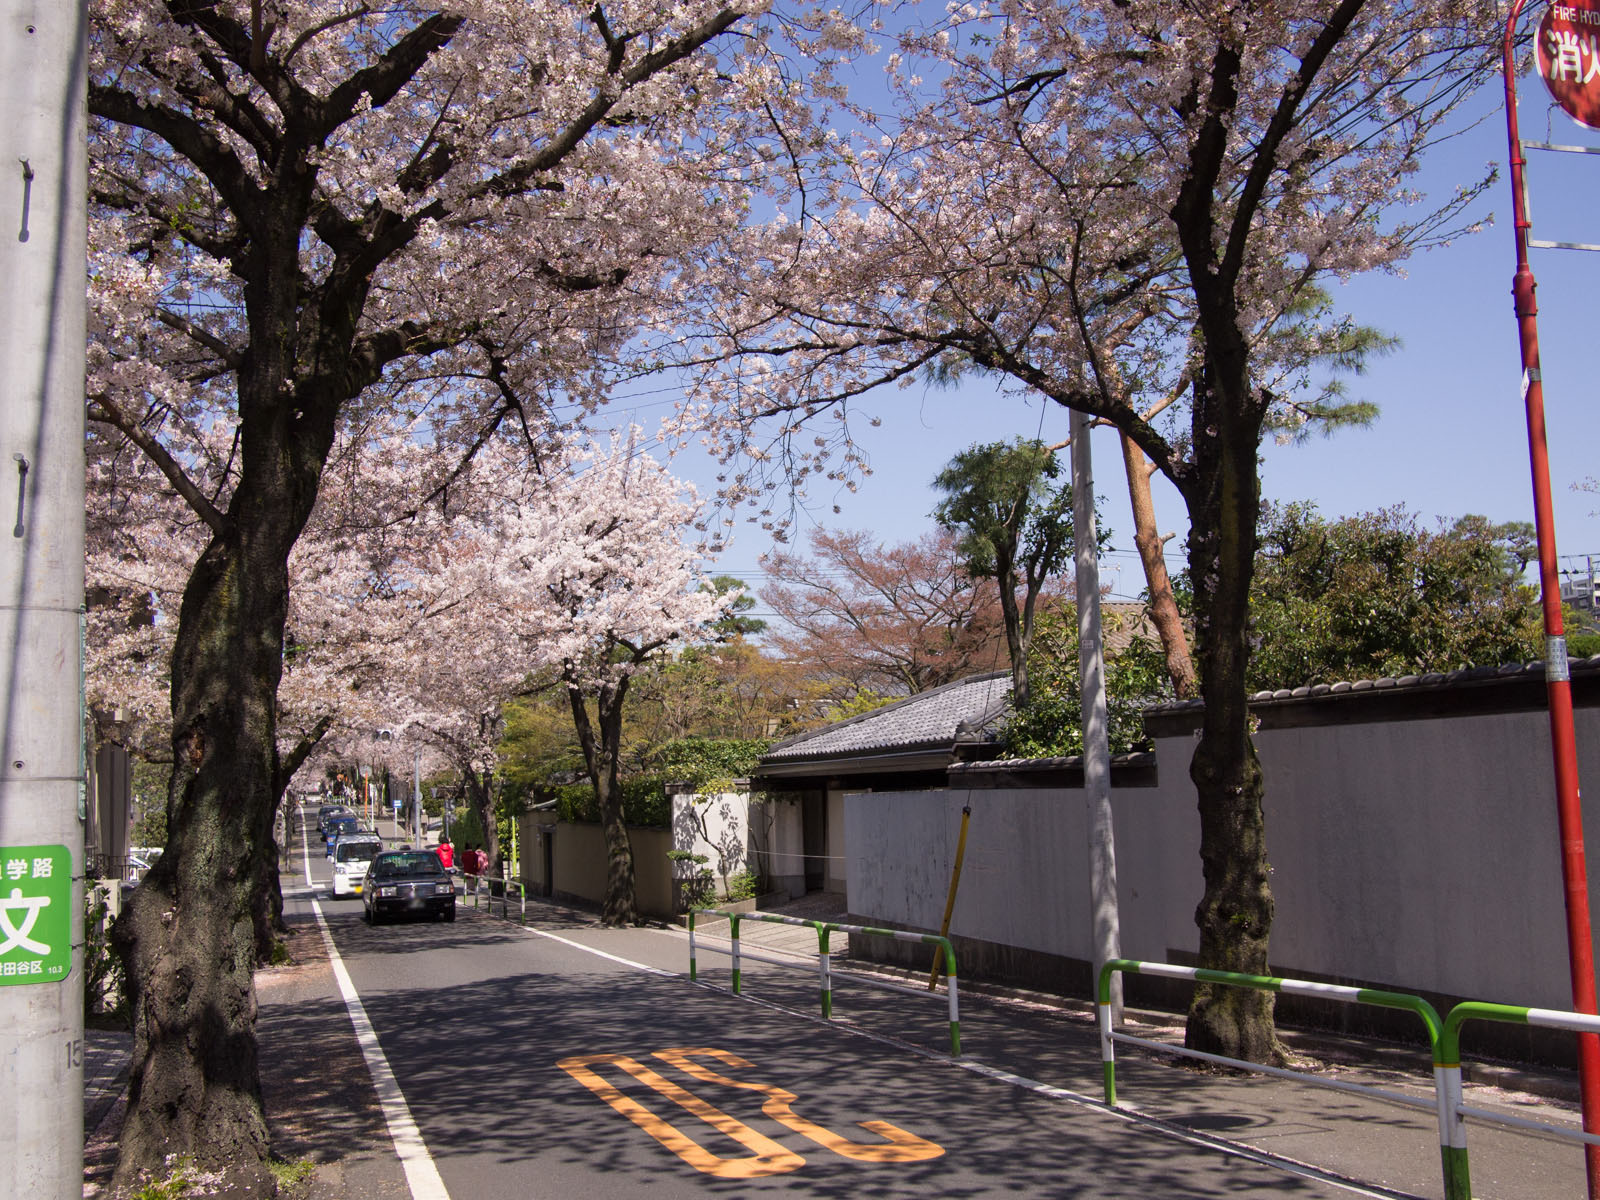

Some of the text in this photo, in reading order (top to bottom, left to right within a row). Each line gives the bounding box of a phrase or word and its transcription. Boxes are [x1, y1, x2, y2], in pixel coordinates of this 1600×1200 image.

[1553, 5, 1577, 22] FIRE
[0, 857, 53, 880] 学路
[0, 887, 51, 956] 文
[555, 1047, 946, 1178] 30
